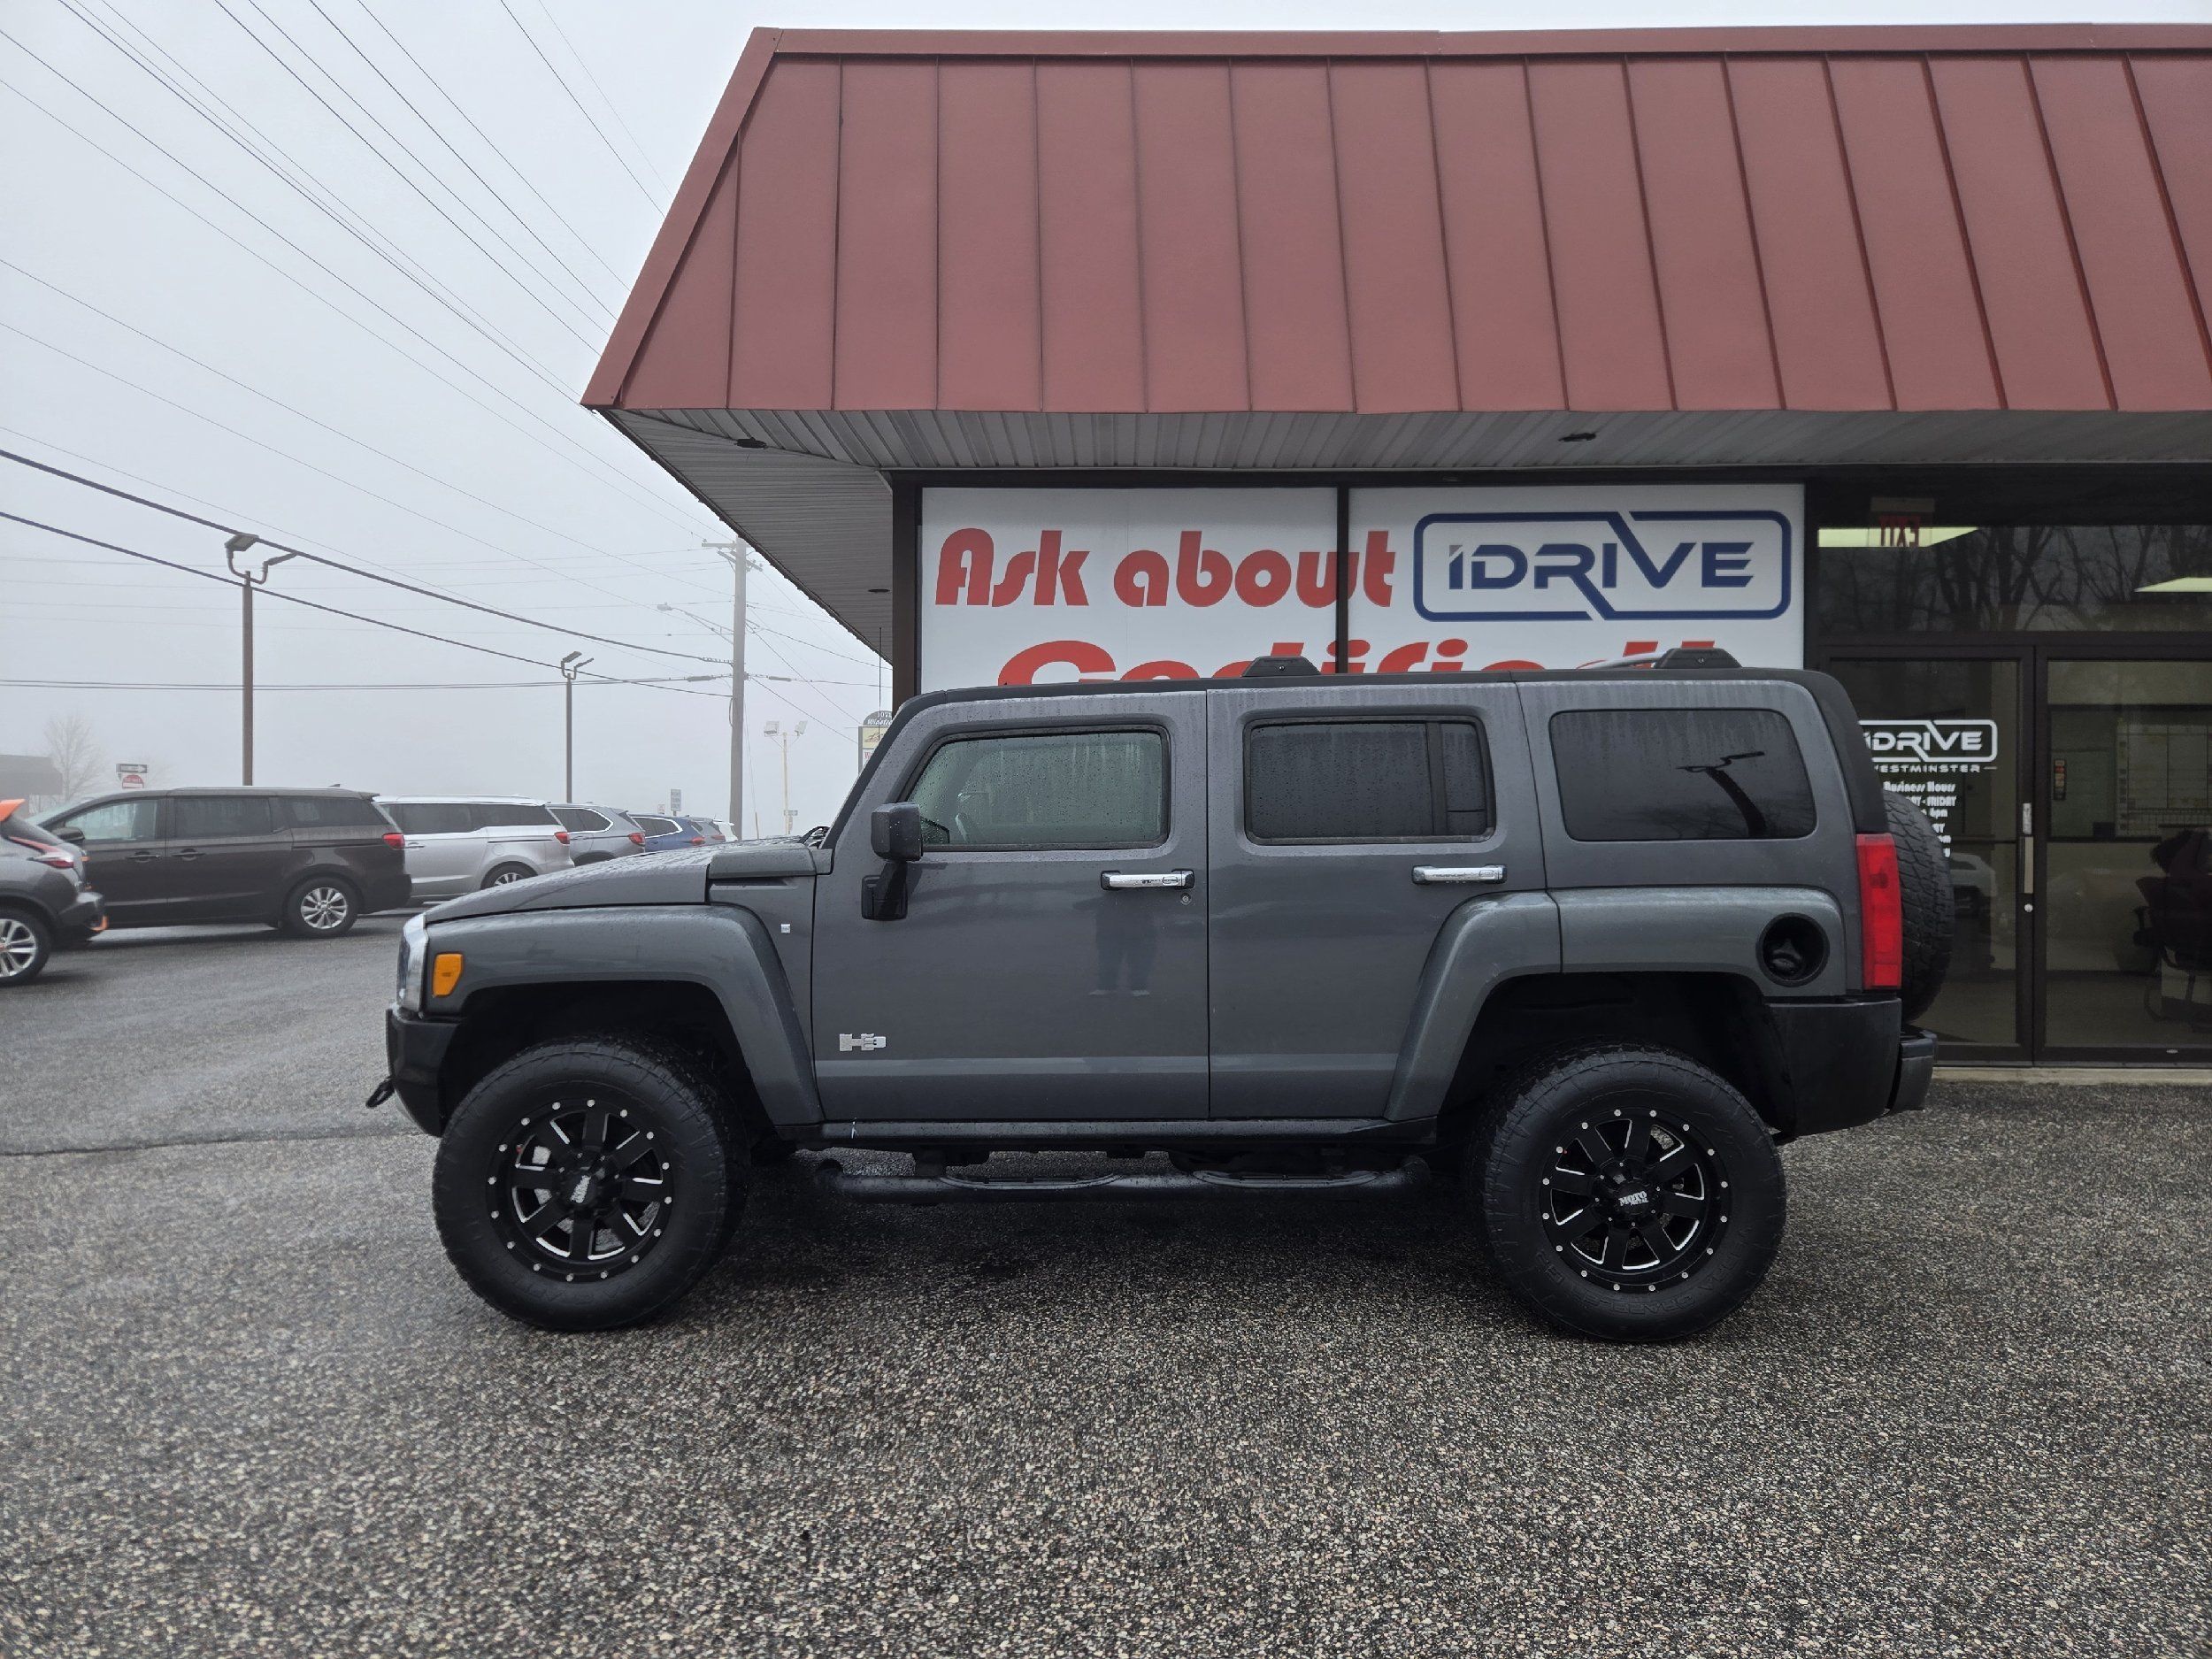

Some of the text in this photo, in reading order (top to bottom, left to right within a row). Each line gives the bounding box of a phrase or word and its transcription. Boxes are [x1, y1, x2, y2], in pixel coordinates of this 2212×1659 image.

[935, 527, 1090, 608] Ask
[1113, 530, 1395, 608] about
[1883, 780, 1956, 793] Business Hours
[1926, 795, 1957, 807] FRIDAY
[1618, 1190, 1647, 1207] MOTO
